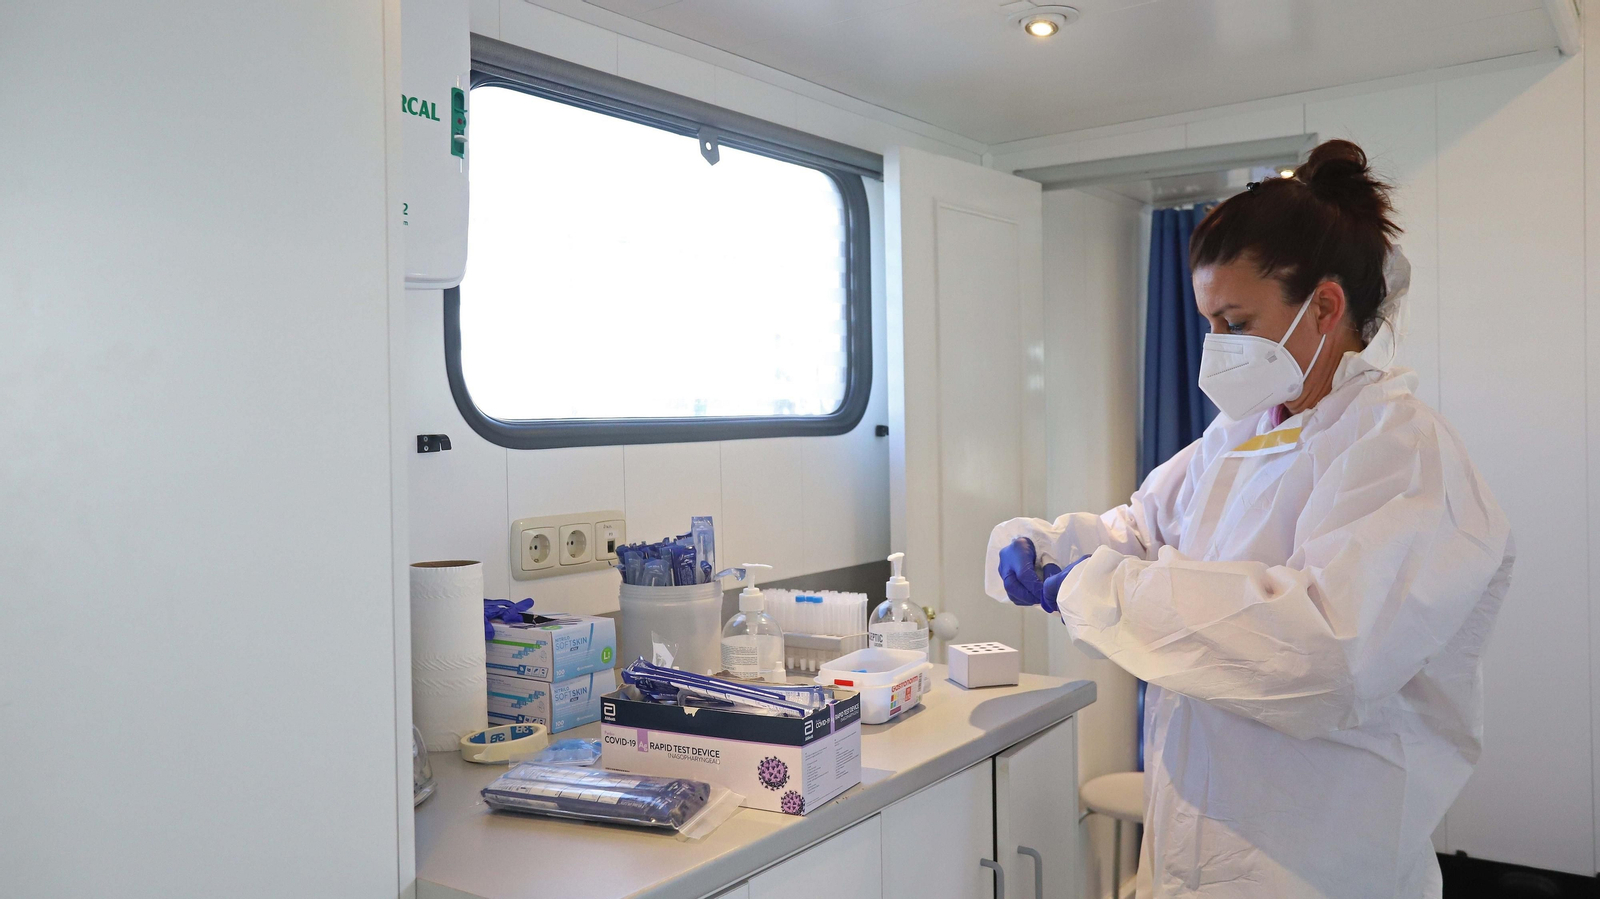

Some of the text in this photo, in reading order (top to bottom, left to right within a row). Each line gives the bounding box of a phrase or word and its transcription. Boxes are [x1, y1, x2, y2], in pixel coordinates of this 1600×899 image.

[555, 636, 588, 651] SOFTSKIN
[553, 686, 570, 694] NITRILO
[554, 686, 588, 702] SOFTSKIN
[490, 732, 505, 743] 3B
[604, 735, 720, 758] COVID-19 Ag RAPID TEST DEVICE
